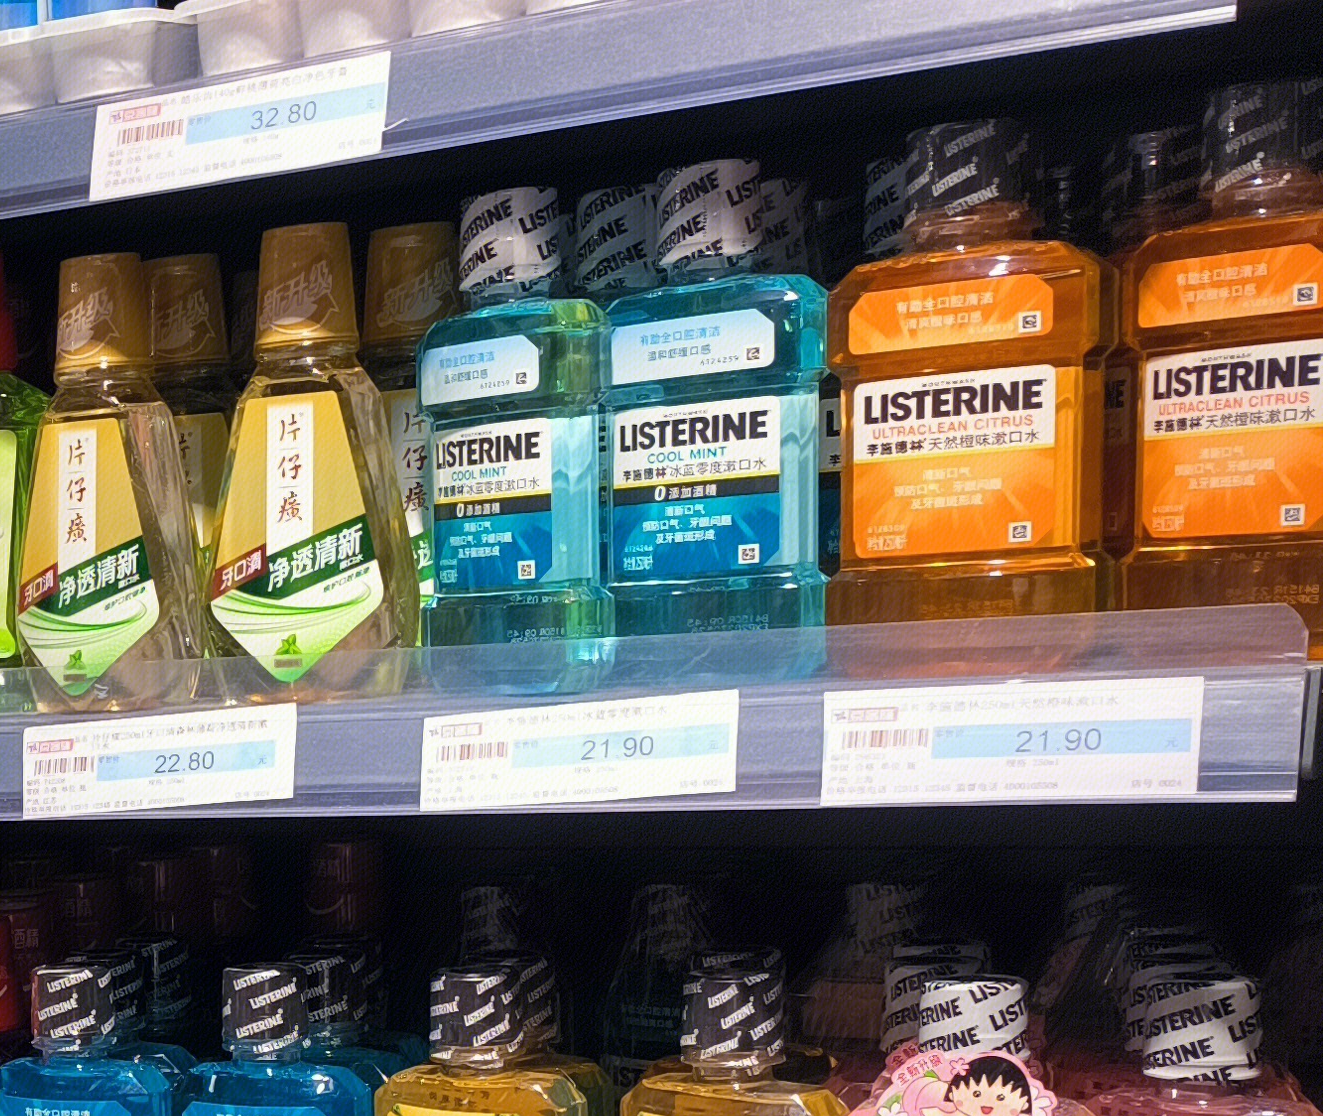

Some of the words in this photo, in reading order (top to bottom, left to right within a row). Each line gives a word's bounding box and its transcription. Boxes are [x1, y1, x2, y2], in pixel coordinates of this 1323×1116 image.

[250, 100, 317, 131] 32.80
[1152, 353, 1321, 401] LISTERINE
[863, 380, 1044, 425] LISTERINE
[1158, 395, 1244, 416] ULTRACLEAN
[1248, 391, 1310, 408] CITRUS
[619, 410, 768, 454] LISTERINE
[872, 420, 968, 440] ULTRACLEAN
[973, 414, 1034, 429] CITRUS
[436, 431, 541, 471] LISTERINE
[647, 449, 684, 464] COOL
[689, 446, 726, 460] MINT
[451, 469, 477, 481] COOL
[479, 466, 507, 479] MINT
[266, 525, 364, 592] 净透清新
[56, 542, 141, 610] 净透清新
[580, 735, 654, 762] 21.90
[1015, 728, 1102, 753] 21.90
[153, 749, 215, 773] 22.80
